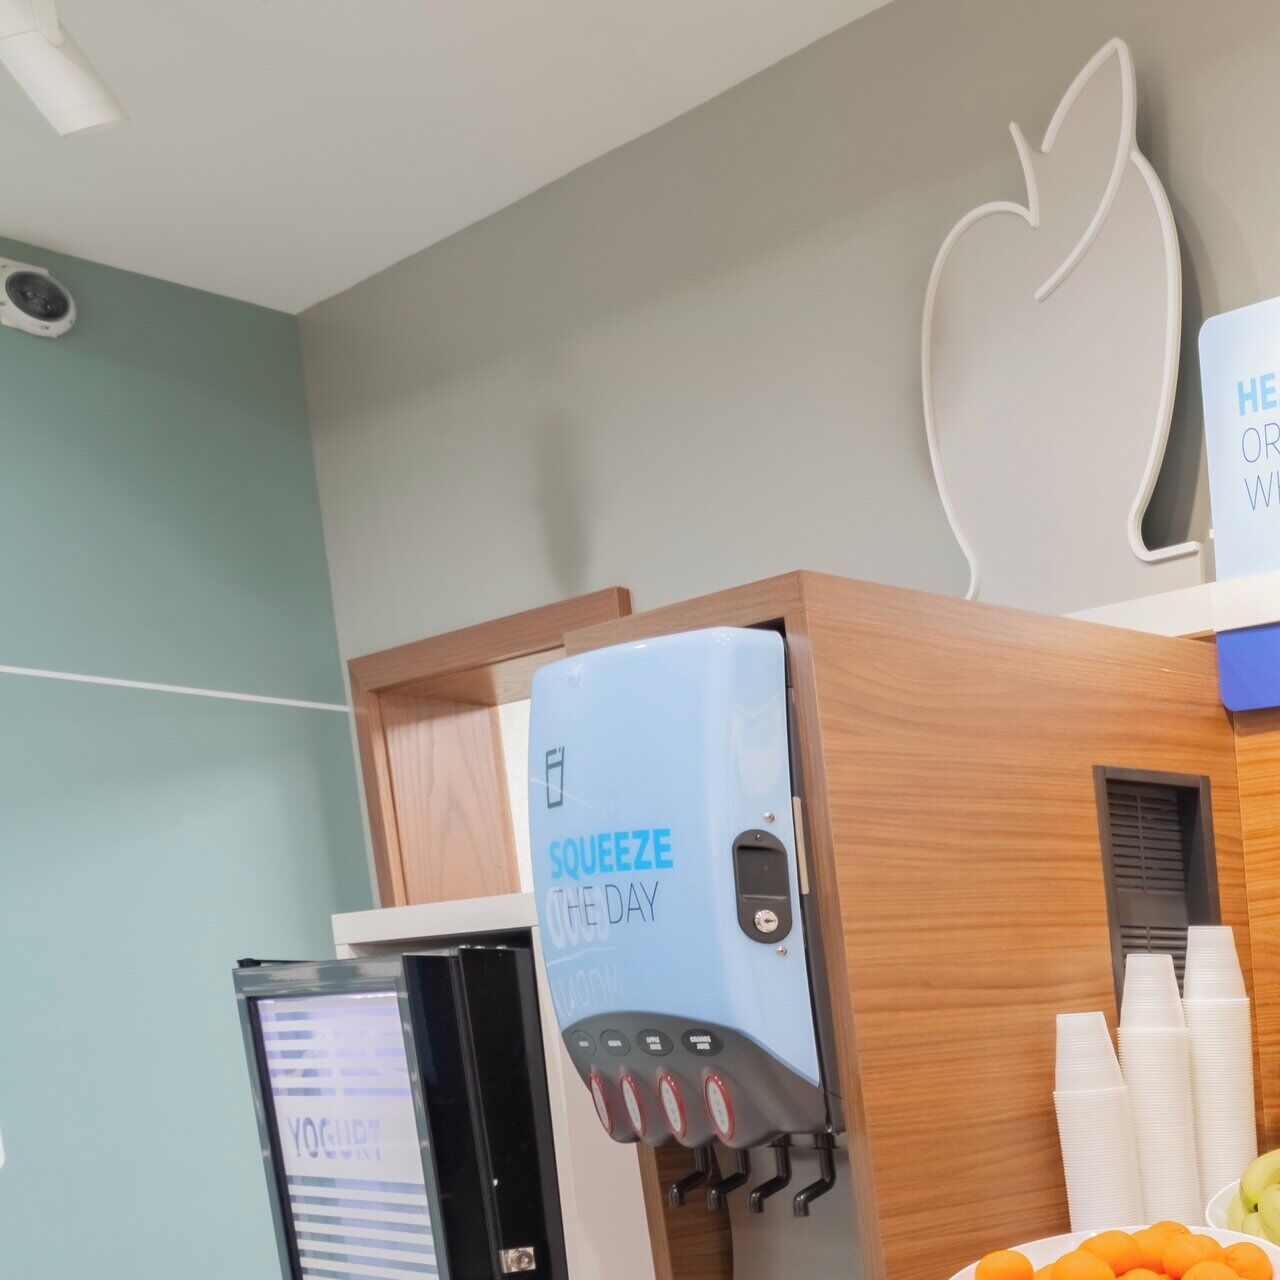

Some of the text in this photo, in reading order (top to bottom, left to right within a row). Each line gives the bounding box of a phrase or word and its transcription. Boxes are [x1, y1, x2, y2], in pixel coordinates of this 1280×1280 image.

[550, 828, 673, 880] SQUEEZE
[553, 881, 659, 926] THE DAY
[287, 1117, 381, 1162] YOGURT
